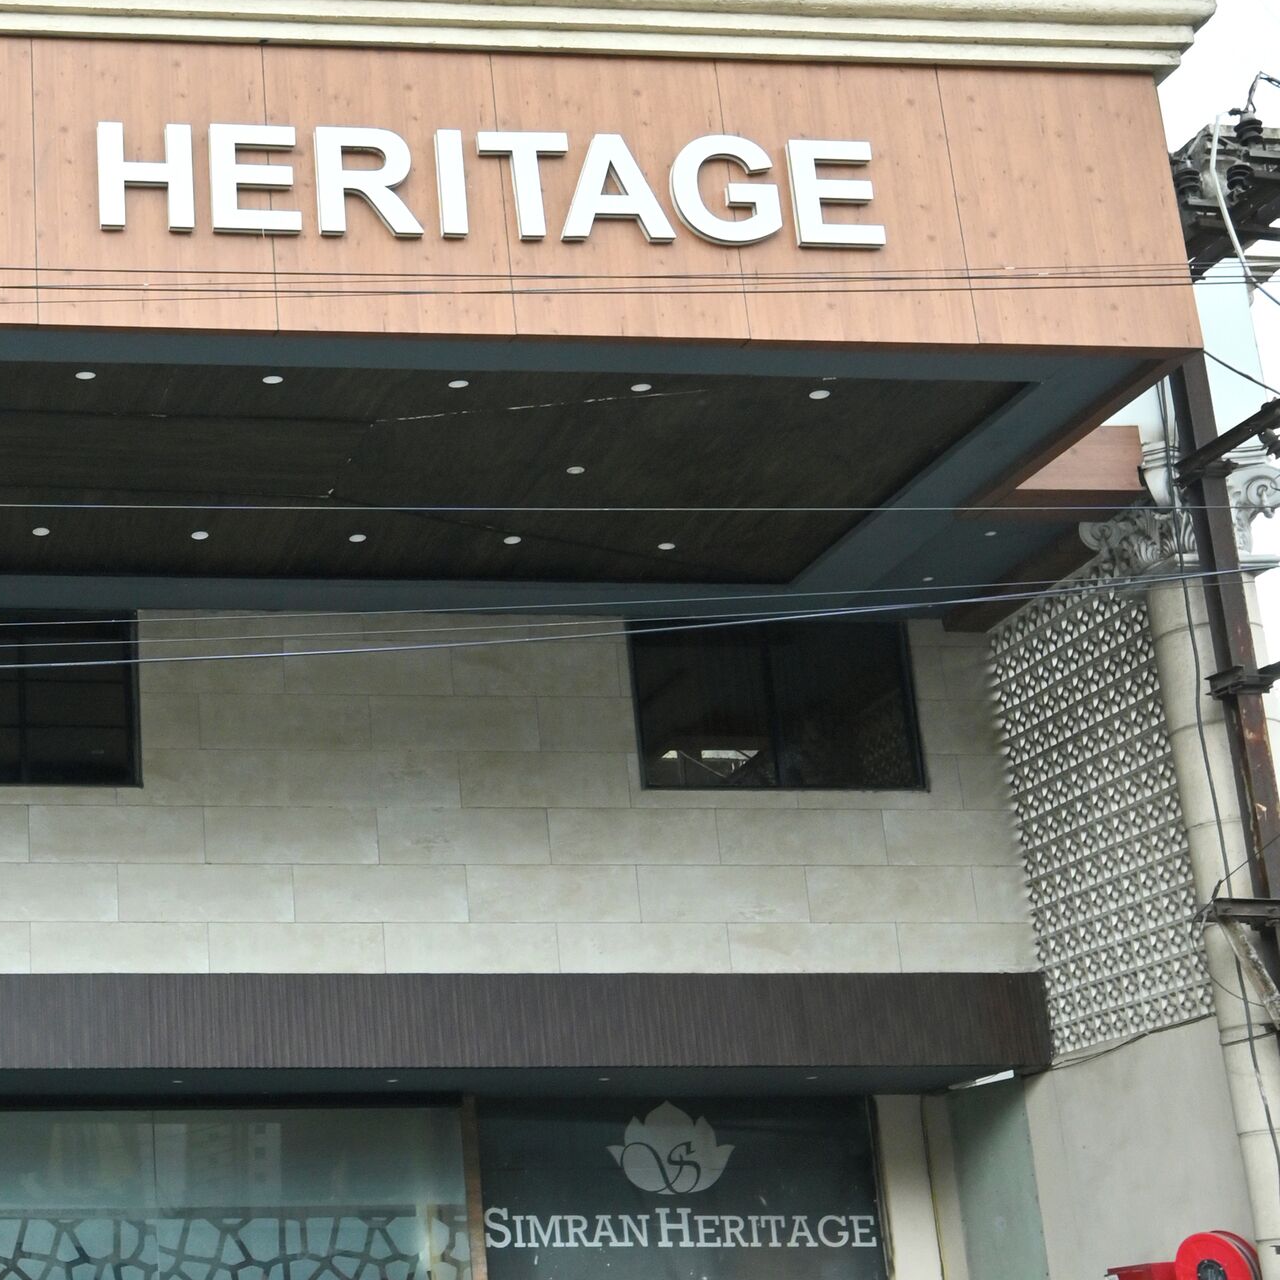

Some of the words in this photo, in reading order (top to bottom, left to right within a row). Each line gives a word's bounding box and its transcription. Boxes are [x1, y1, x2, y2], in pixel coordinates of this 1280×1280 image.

[96, 120, 887, 250] HERITAGE
[484, 1207, 650, 1248] SIMRAN
[655, 1208, 878, 1248] HERITAGE
